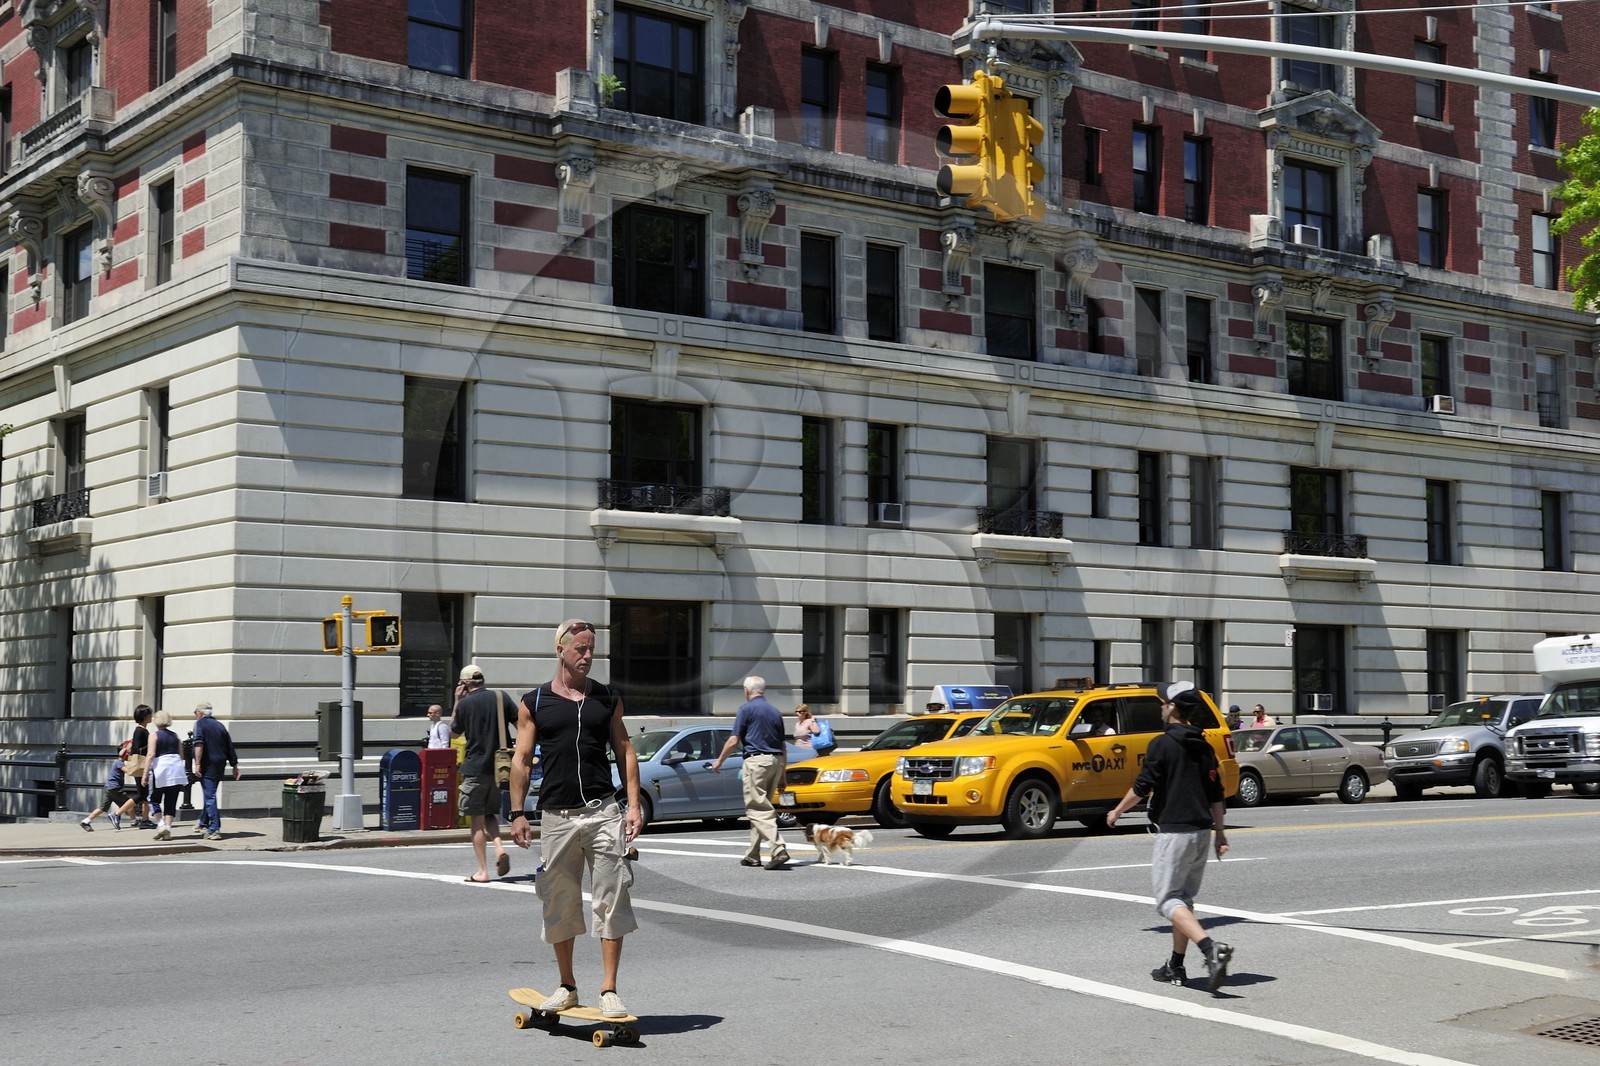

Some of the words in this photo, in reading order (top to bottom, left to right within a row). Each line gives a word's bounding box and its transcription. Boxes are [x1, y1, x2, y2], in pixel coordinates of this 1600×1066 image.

[1072, 762, 1091, 771] NYC
[1092, 754, 1124, 773] TAXI
[392, 773, 417, 781] SPORTS
